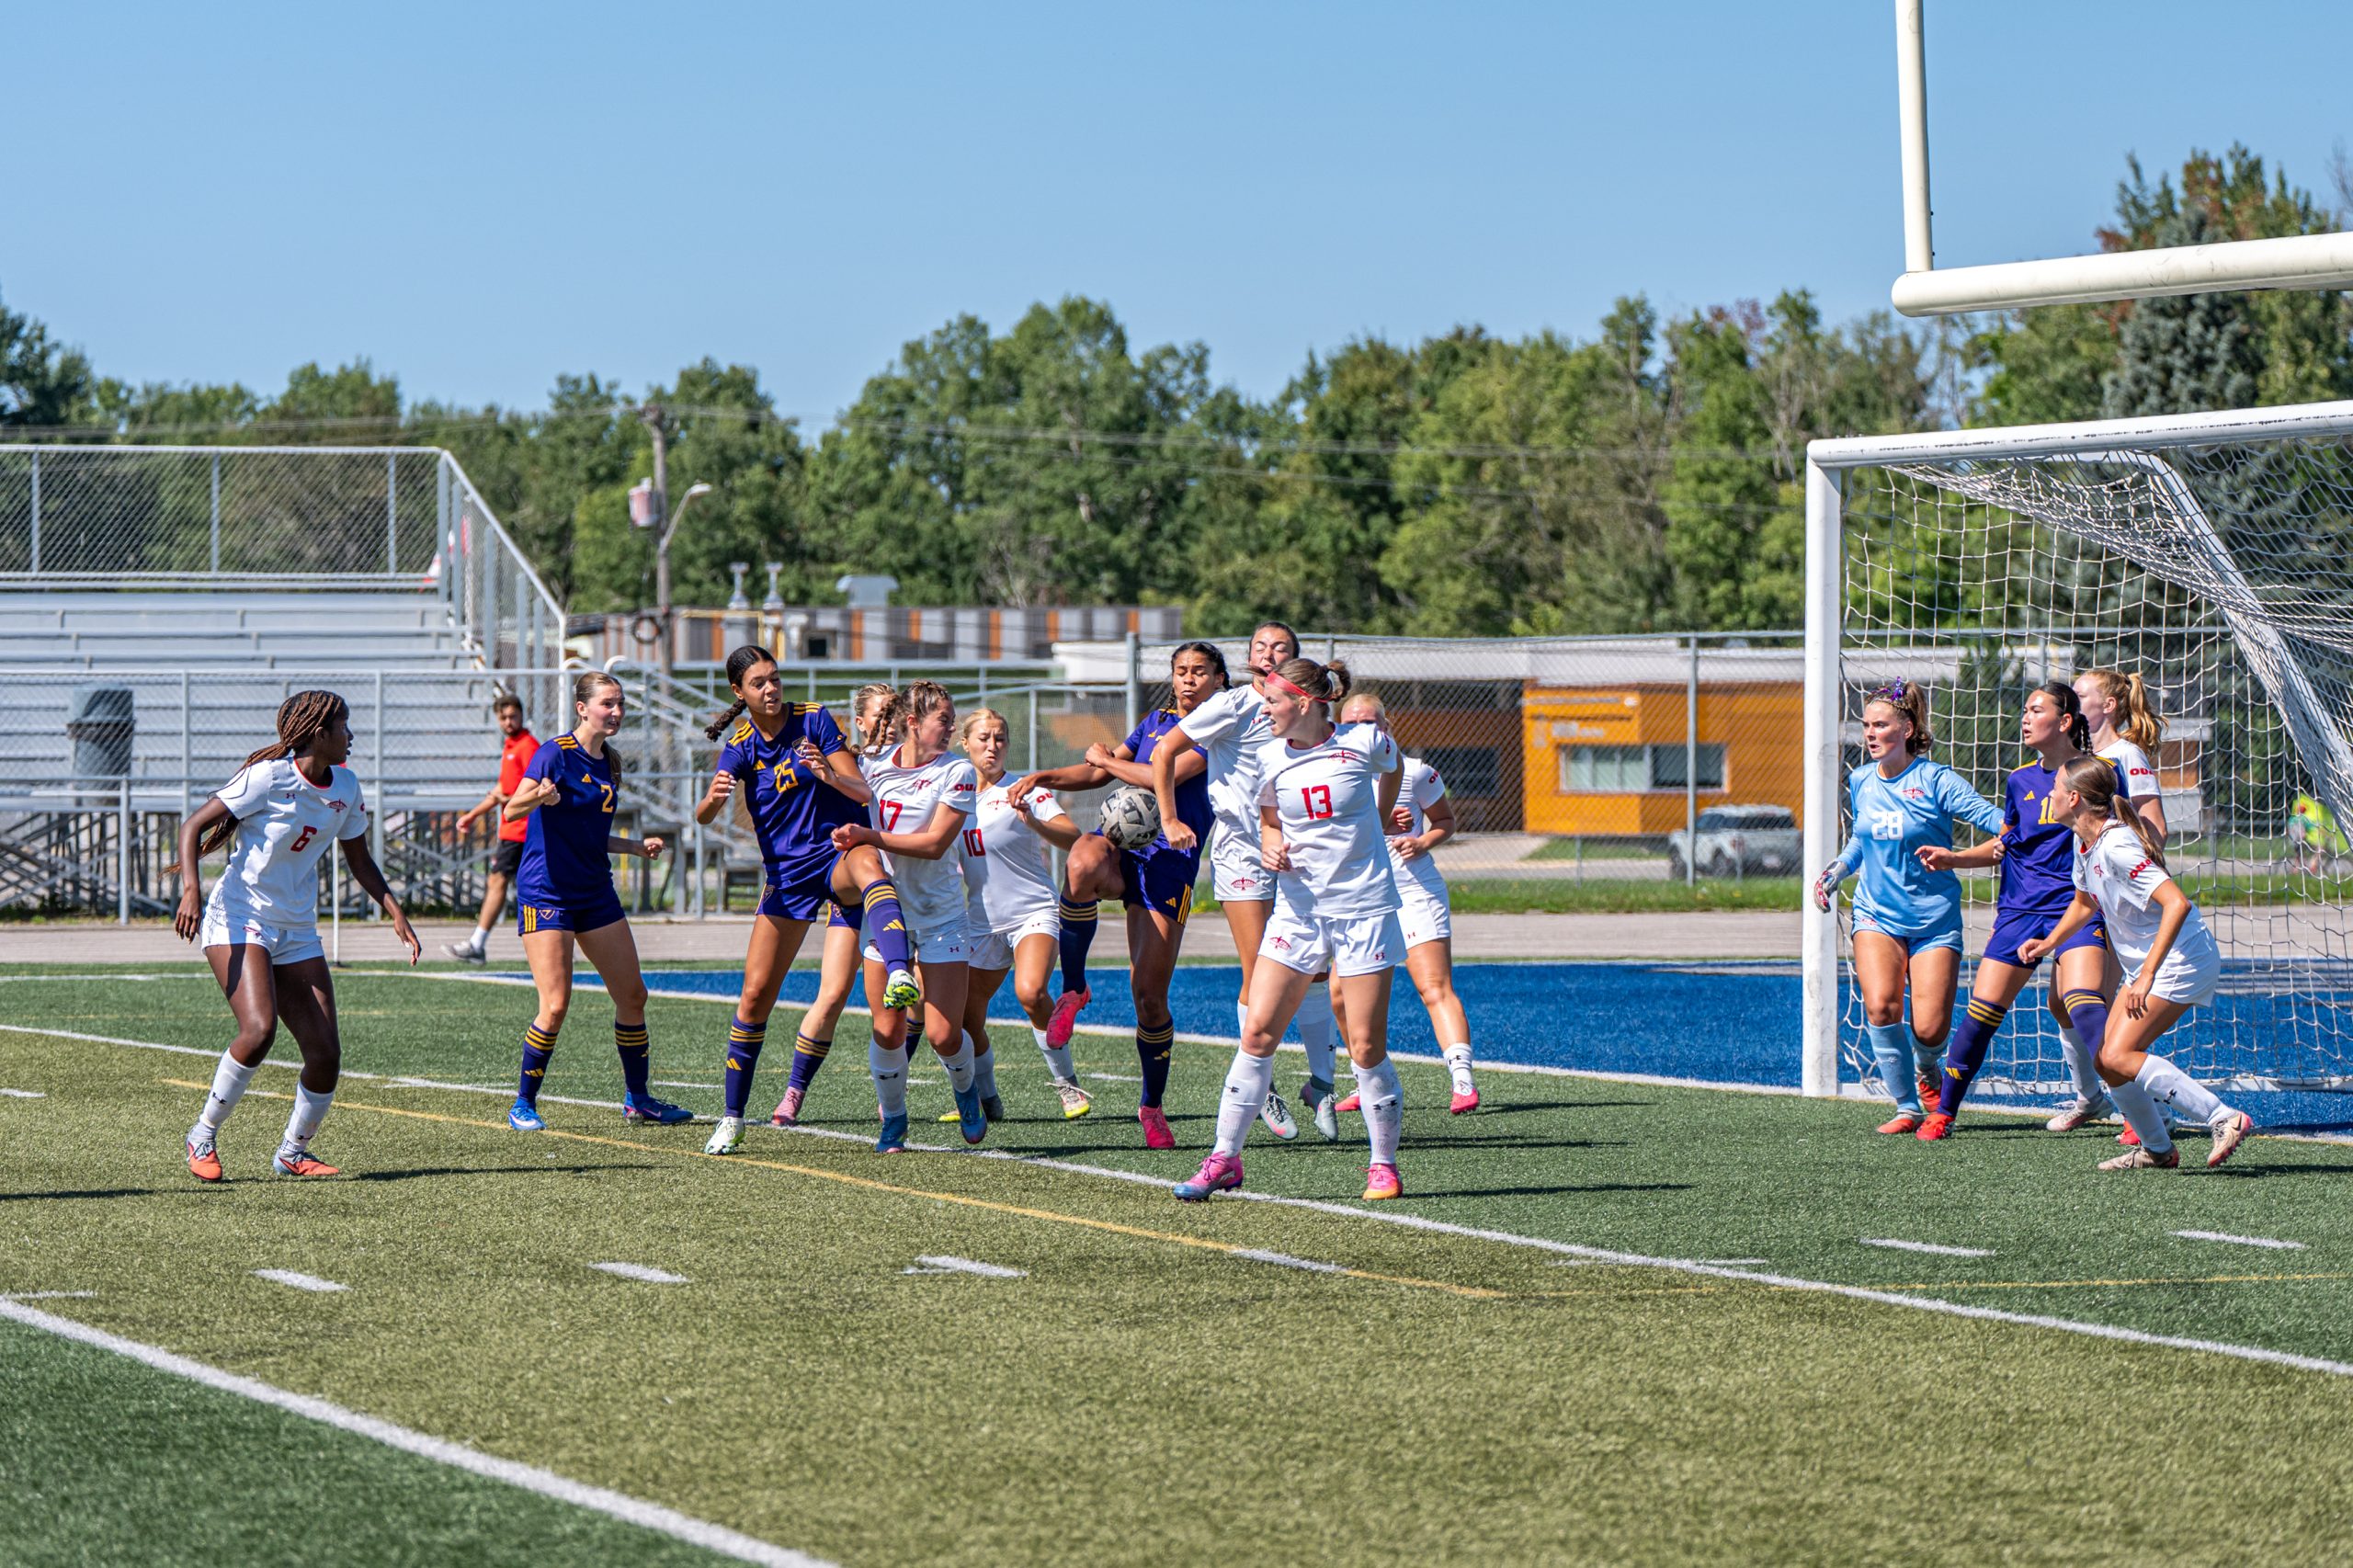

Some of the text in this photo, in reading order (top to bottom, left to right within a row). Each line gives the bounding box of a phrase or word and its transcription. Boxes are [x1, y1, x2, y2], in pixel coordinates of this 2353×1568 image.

[774, 757, 799, 793] 25
[954, 783, 976, 791] OU
[600, 784, 614, 813] 2
[1302, 784, 1333, 820] 13
[879, 798, 904, 831] 17
[1871, 811, 1904, 840] 28
[290, 825, 317, 853] 6
[962, 828, 986, 858] 10
